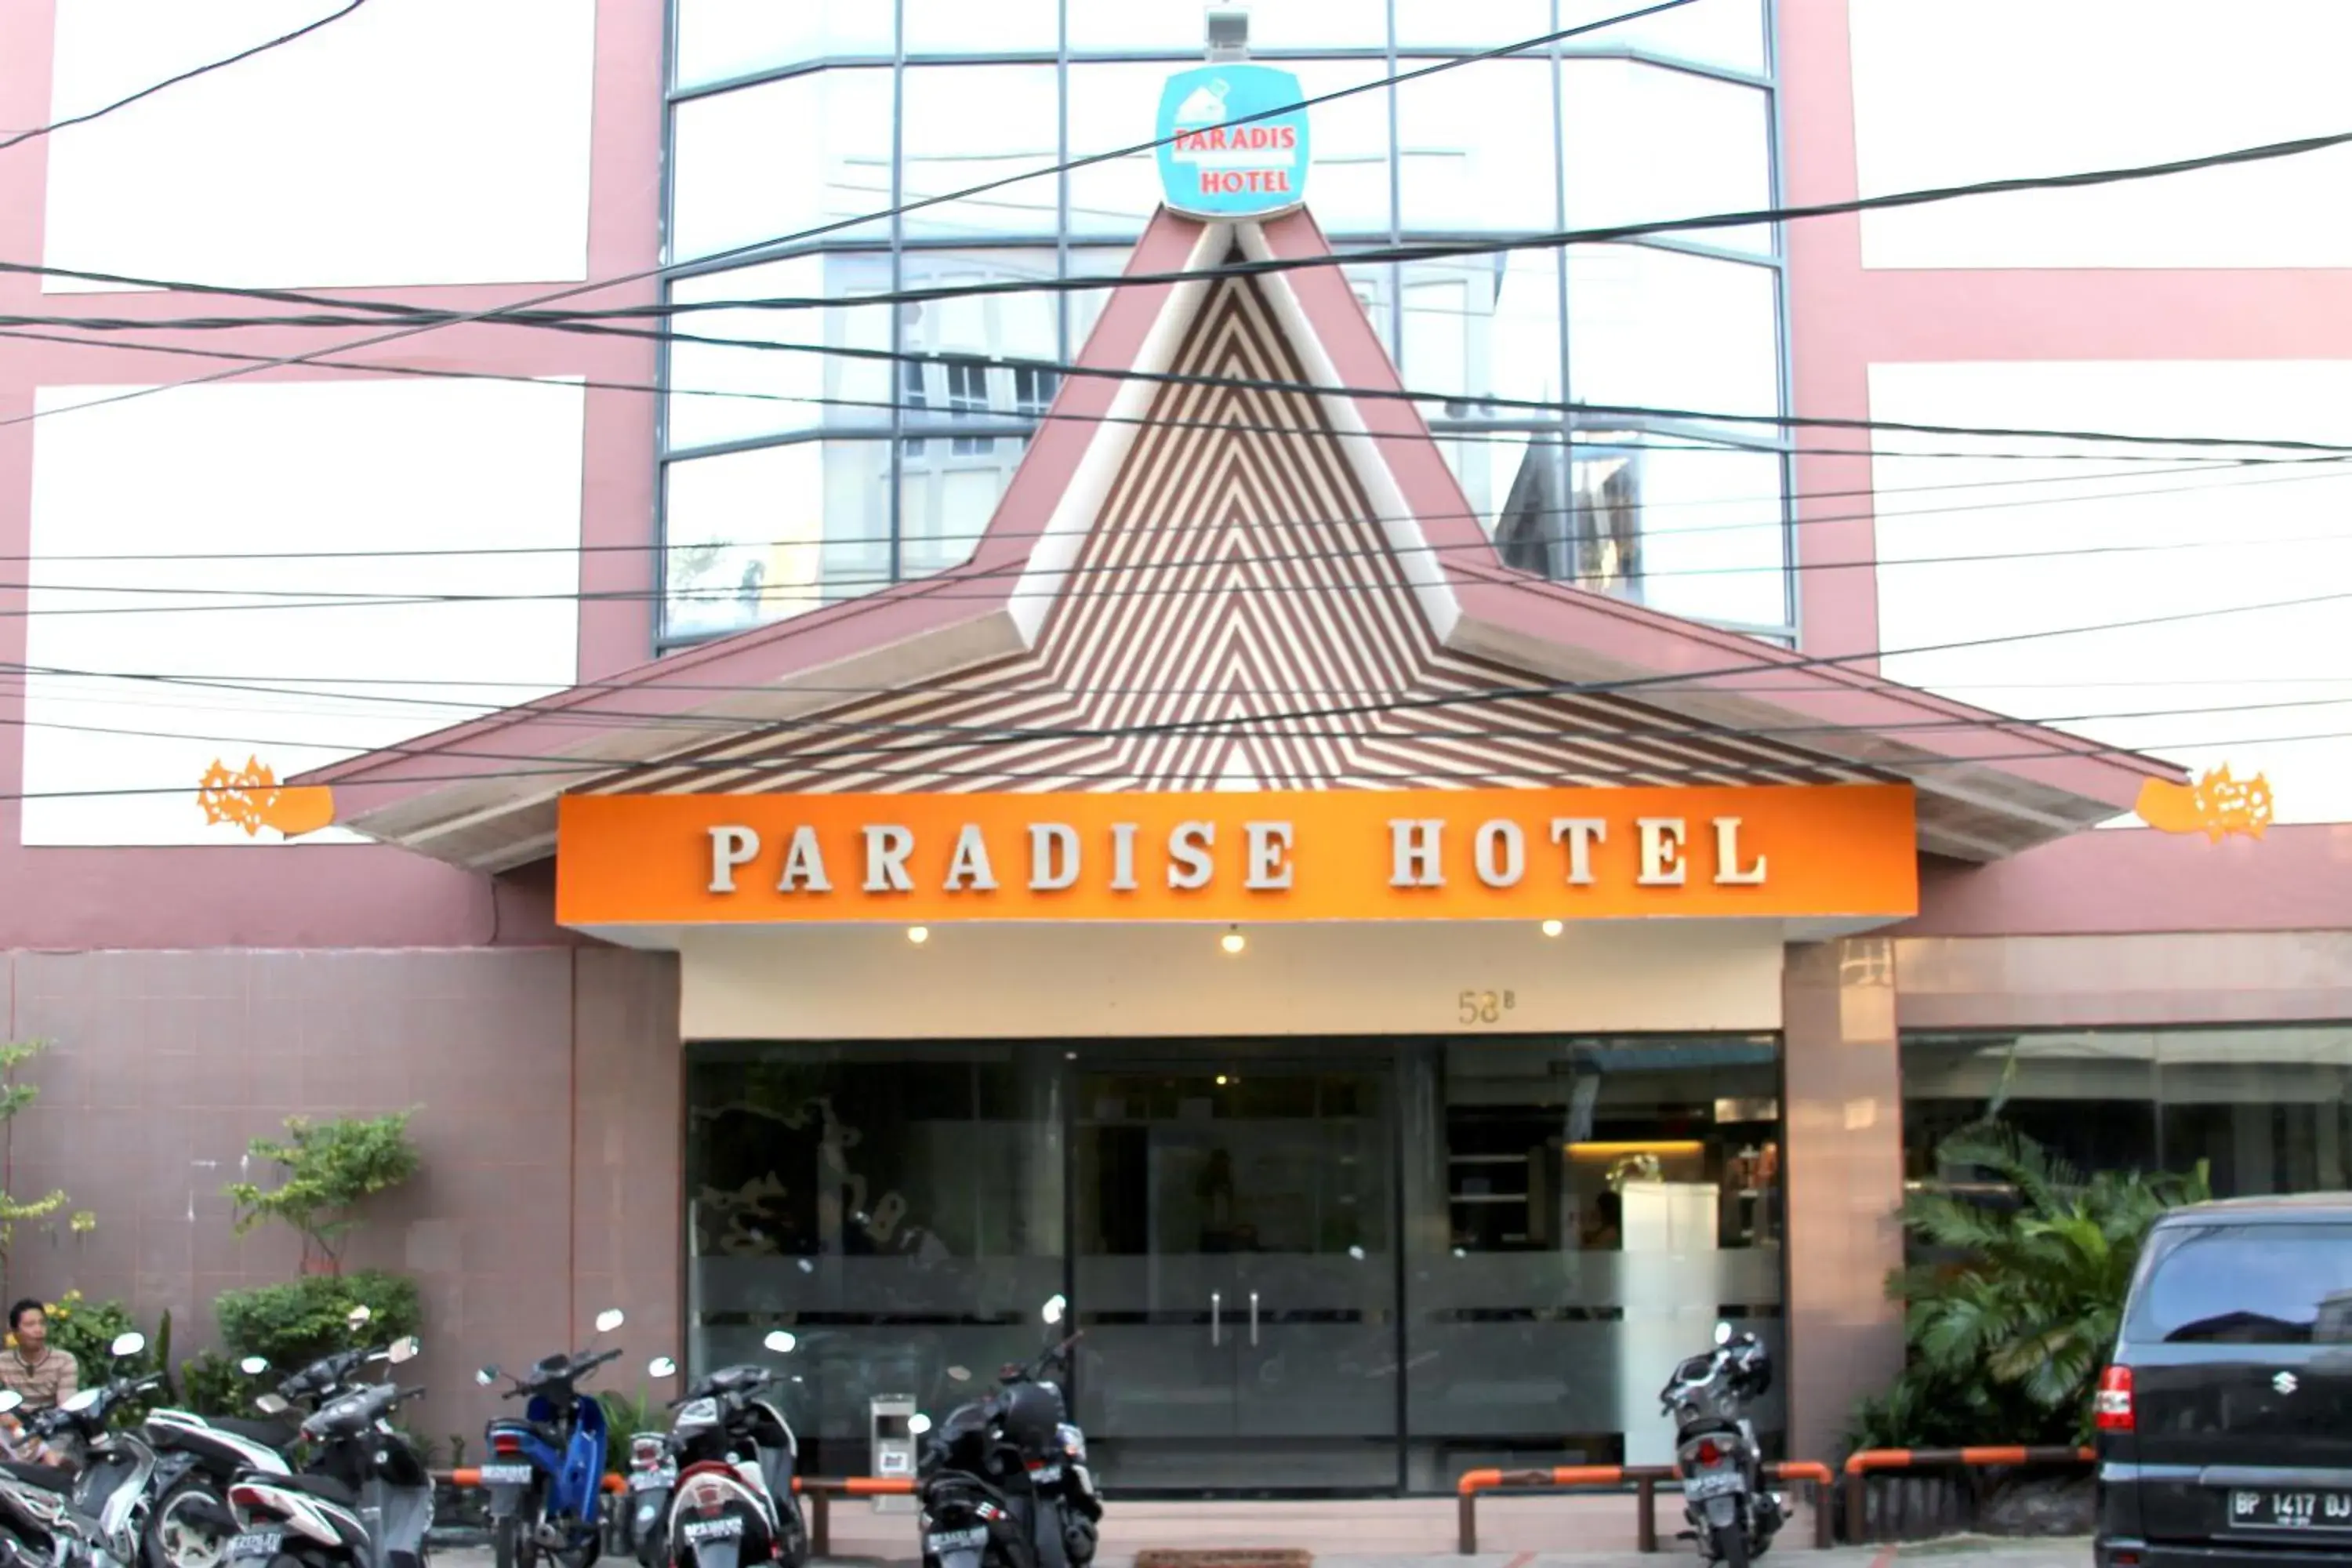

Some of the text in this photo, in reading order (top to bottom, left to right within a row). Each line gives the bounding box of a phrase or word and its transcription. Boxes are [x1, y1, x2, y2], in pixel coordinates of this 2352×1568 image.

[1174, 127, 1295, 151] PARADIS
[1201, 170, 1290, 194] HOTEL
[706, 817, 1767, 891] PARADISE HOTEL
[2236, 1491, 2260, 1515] BP
[2273, 1493, 2316, 1516] 1417
